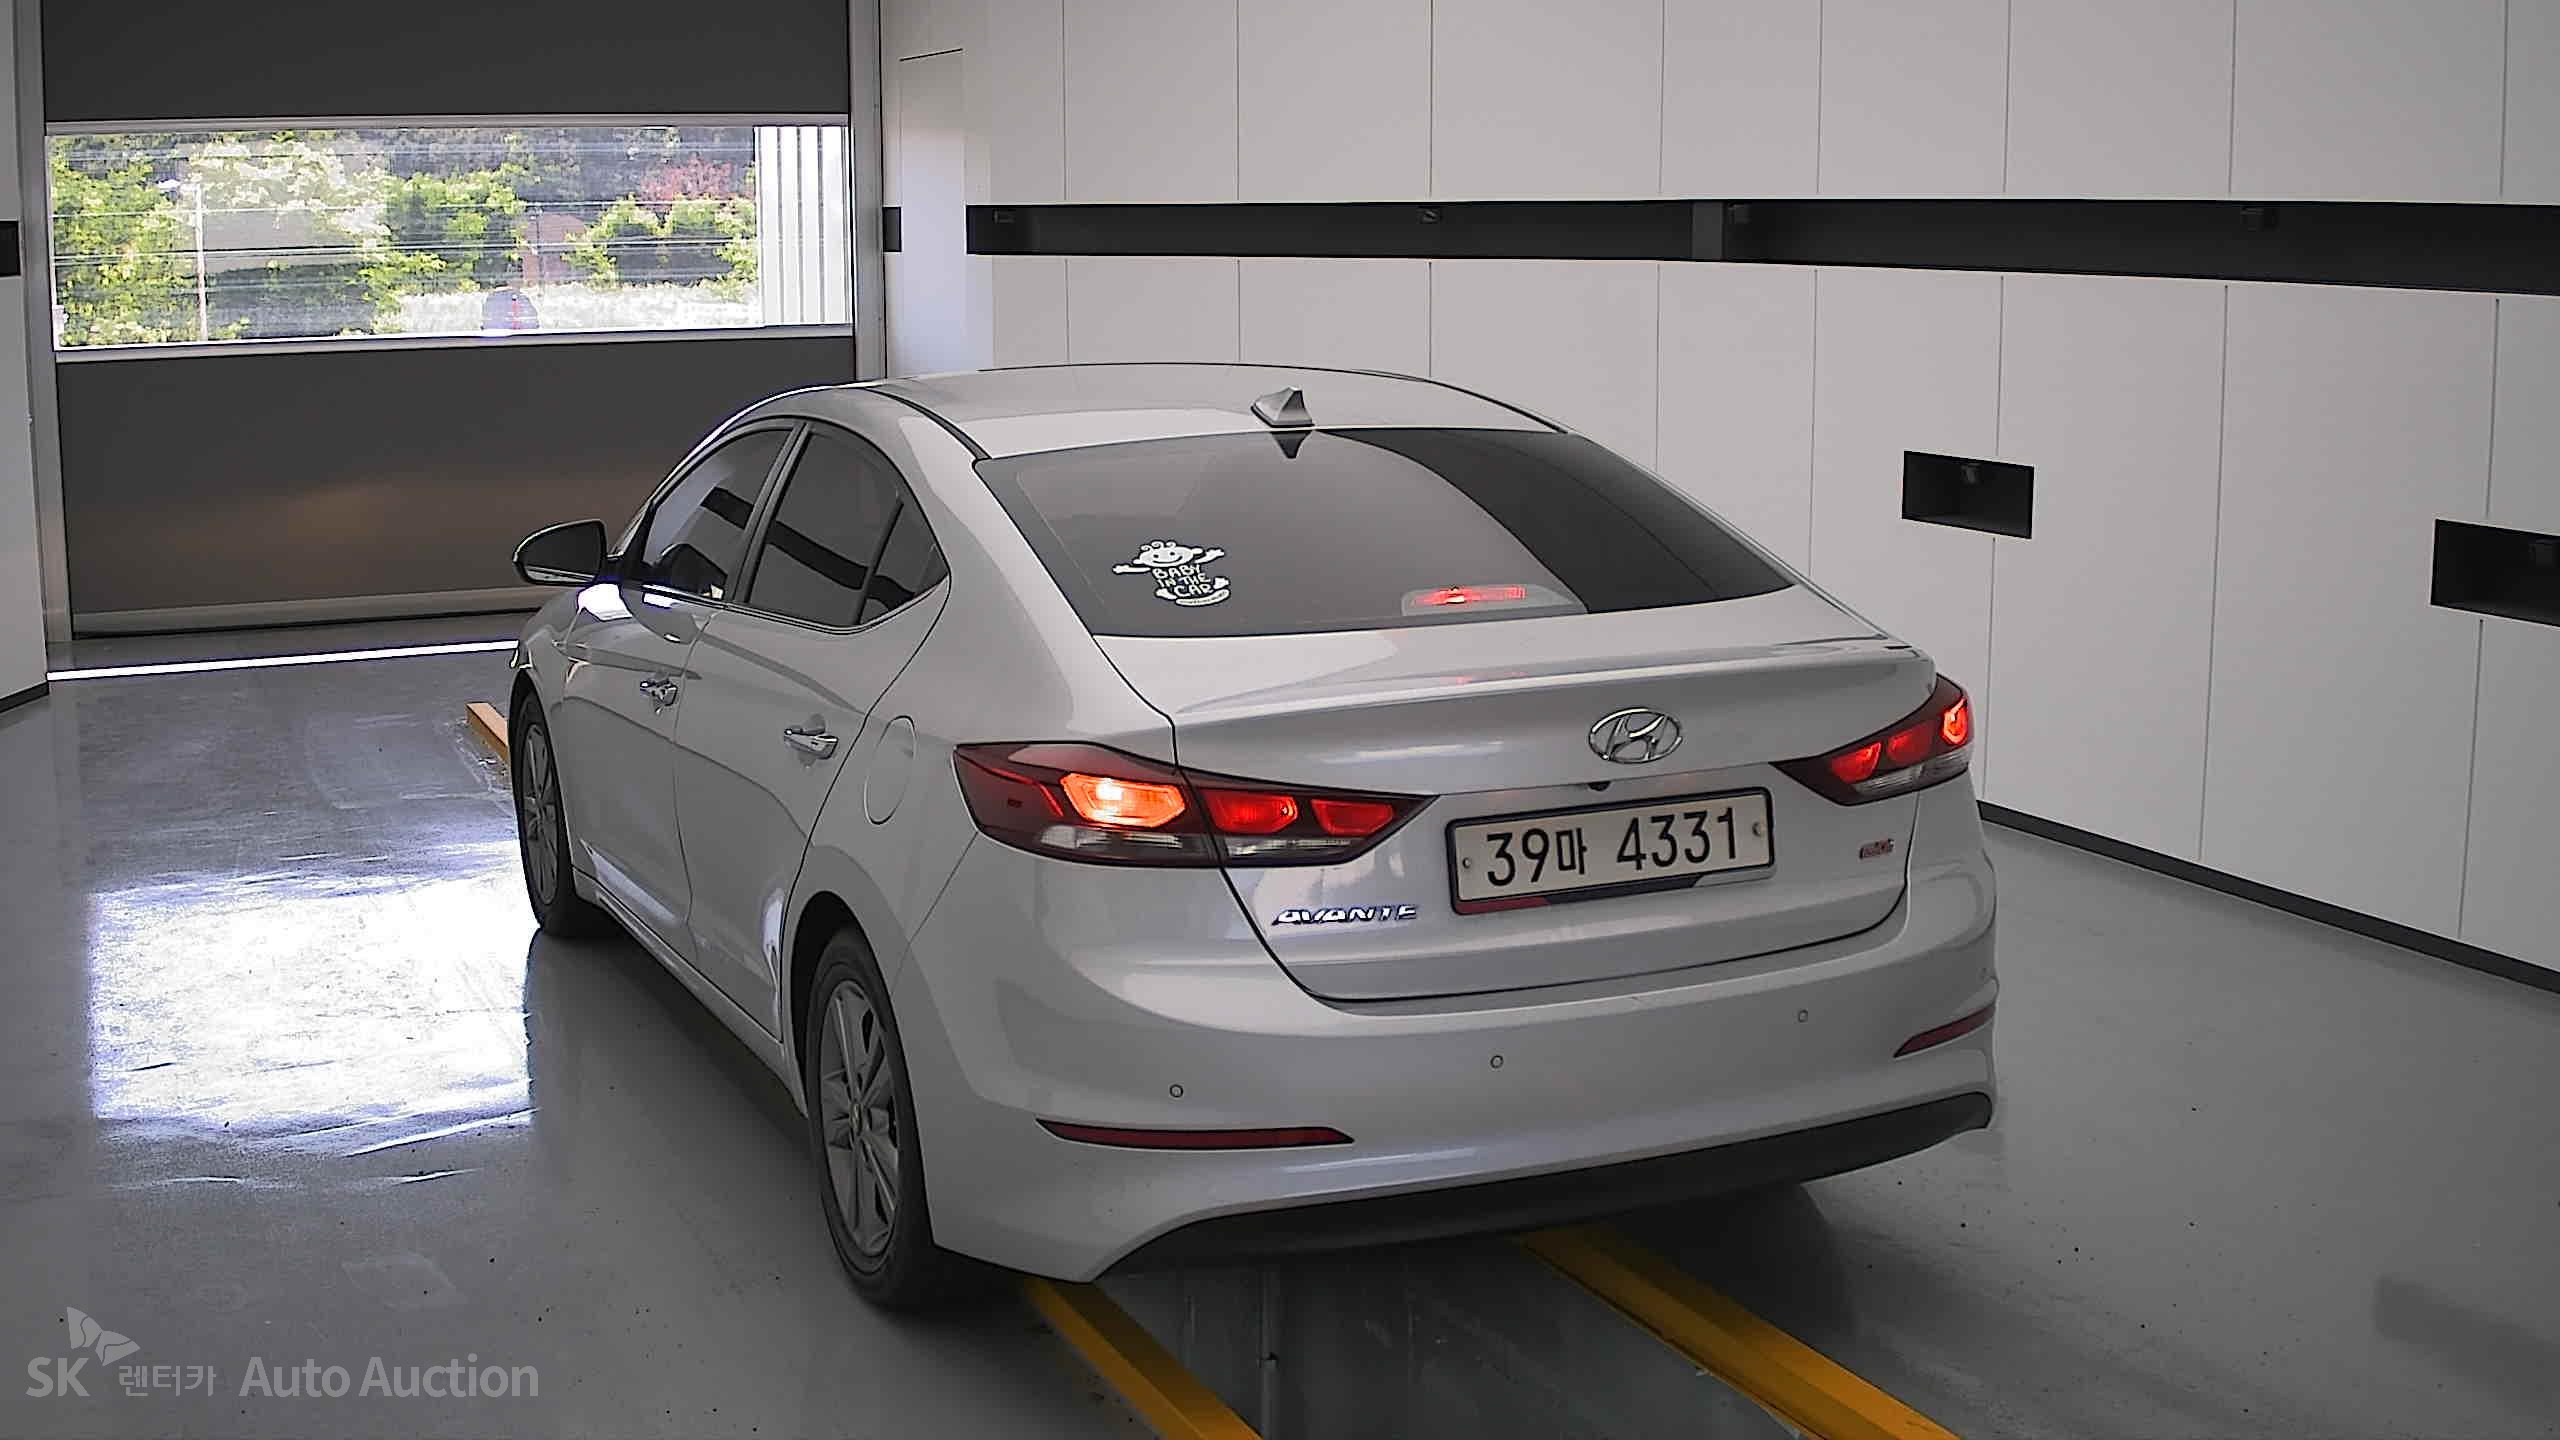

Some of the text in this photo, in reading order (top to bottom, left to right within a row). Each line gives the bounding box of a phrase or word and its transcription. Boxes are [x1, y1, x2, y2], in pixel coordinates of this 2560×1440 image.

[1152, 564, 1201, 579] BABY
[1157, 573, 1211, 588] IN THE
[1174, 584, 1214, 597] CAR
[1485, 806, 1737, 887] 39마 4331
[1273, 904, 1417, 924] AVANTE
